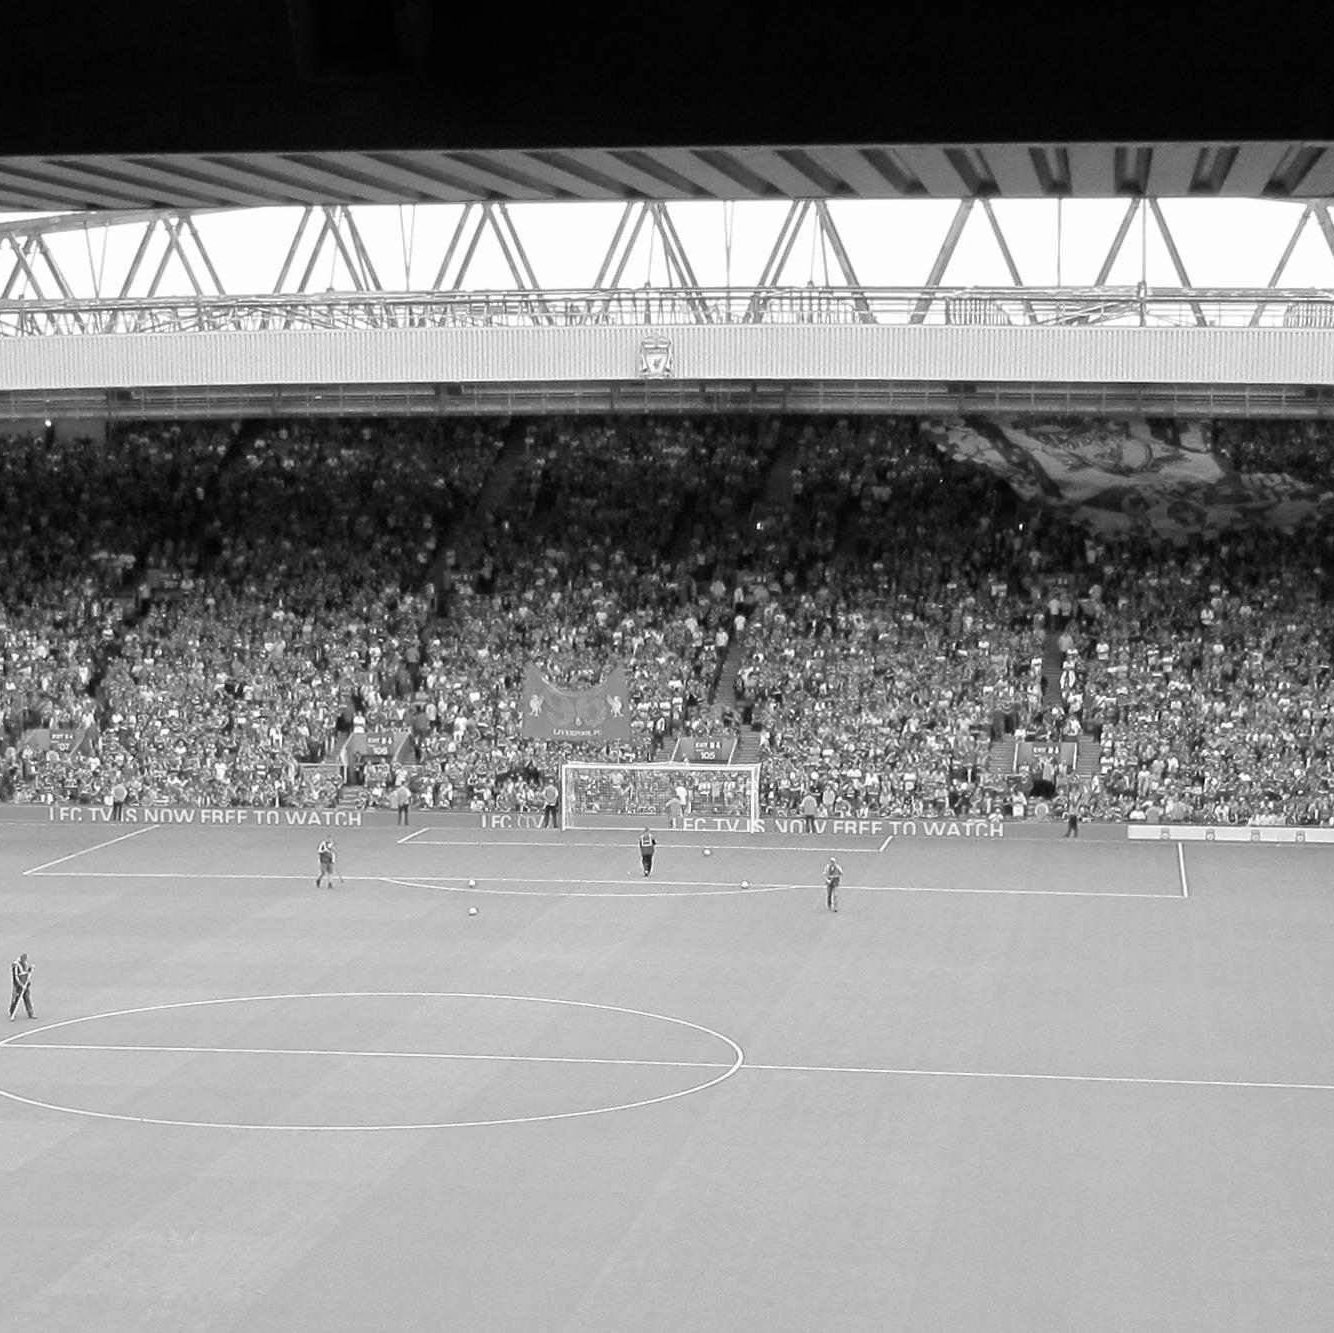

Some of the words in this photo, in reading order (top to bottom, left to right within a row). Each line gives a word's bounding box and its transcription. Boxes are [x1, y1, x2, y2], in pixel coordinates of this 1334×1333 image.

[700, 751, 716, 760] 105
[88, 807, 113, 822] TV
[144, 808, 195, 823] NOW
[253, 810, 279, 825] TO
[285, 811, 362, 826] WATCH
[713, 818, 740, 832] TV
[889, 821, 916, 836] TO
[923, 822, 1004, 837] WATCH
